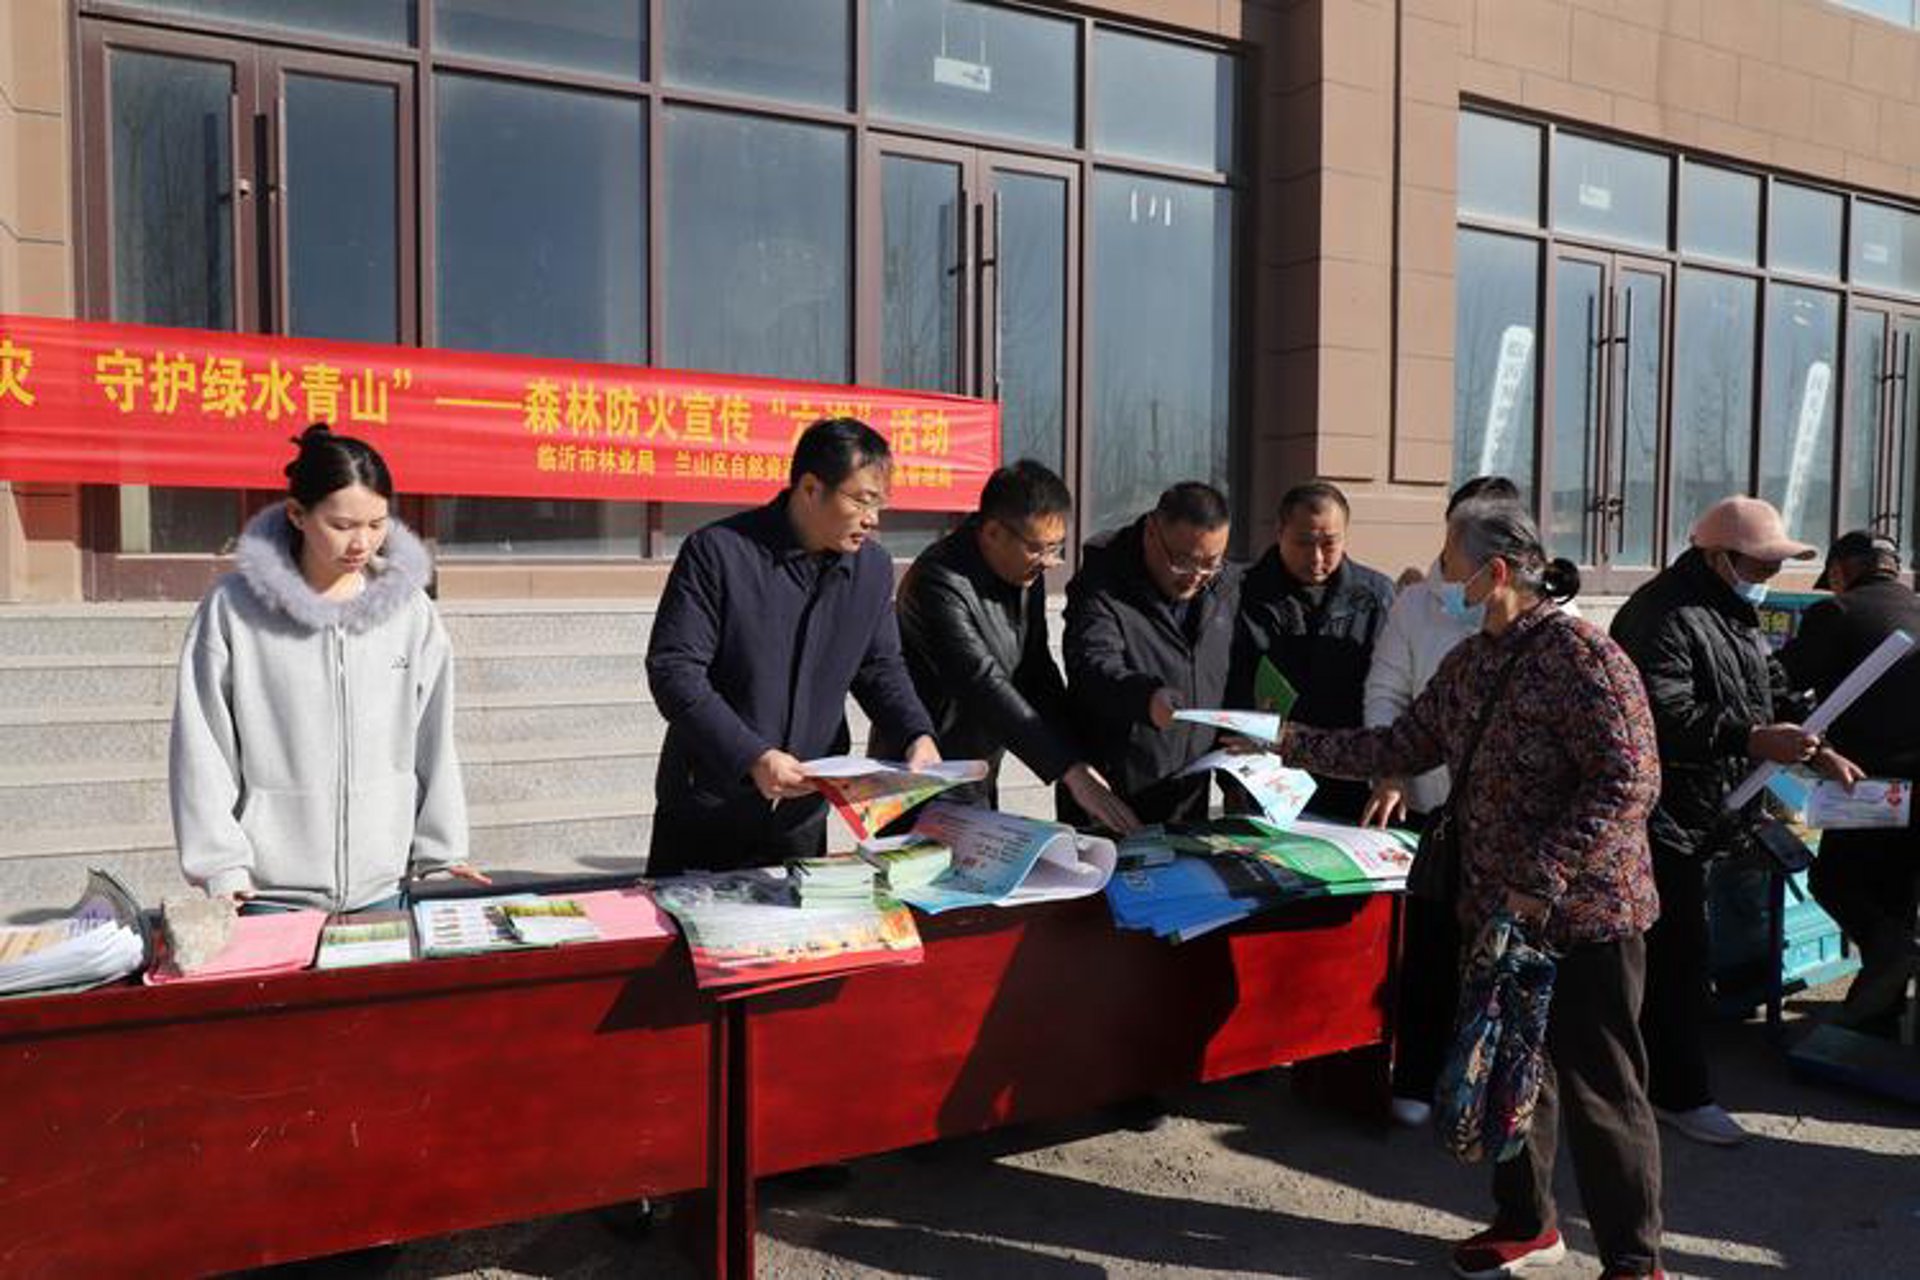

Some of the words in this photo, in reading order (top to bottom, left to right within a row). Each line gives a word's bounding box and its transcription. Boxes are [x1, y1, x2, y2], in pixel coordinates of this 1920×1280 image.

[675, 450, 792, 484] 兰山区自然资
